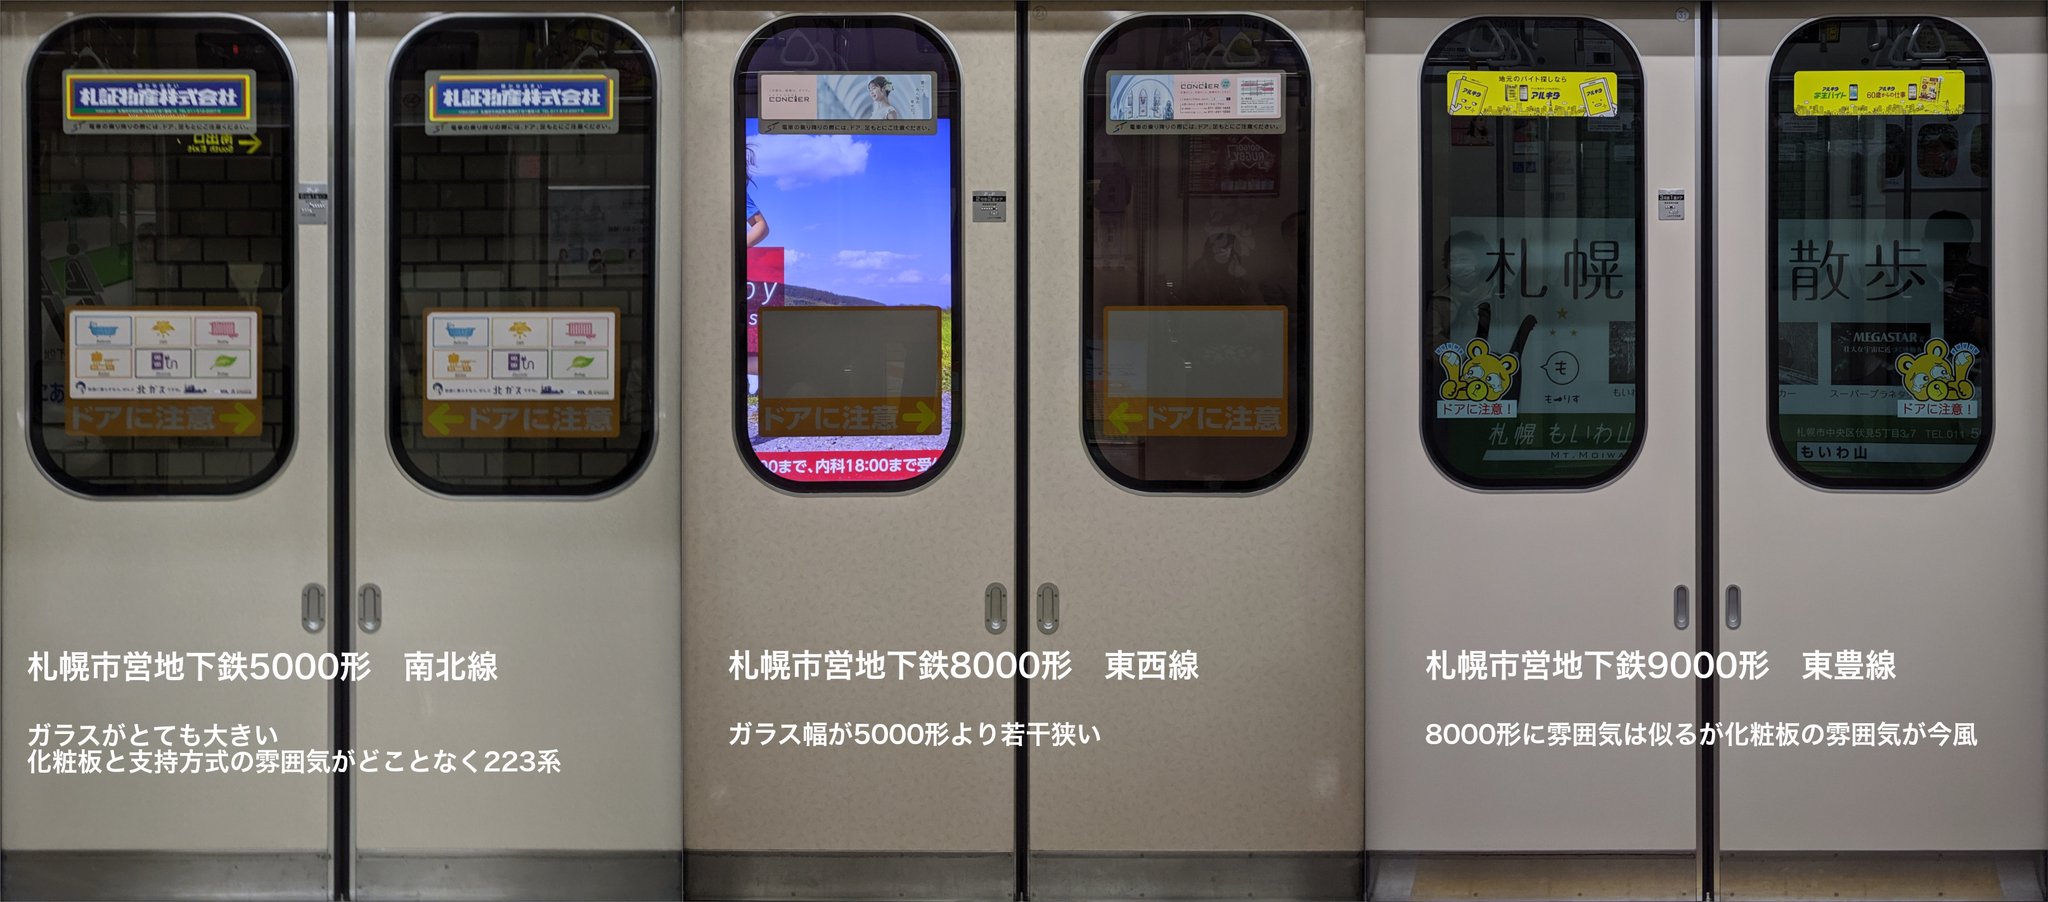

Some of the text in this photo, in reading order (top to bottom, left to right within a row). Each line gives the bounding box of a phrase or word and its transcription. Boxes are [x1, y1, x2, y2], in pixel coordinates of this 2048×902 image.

[443, 88, 600, 107] 札証物産株式会社
[1461, 88, 1482, 98] アルキタ
[1531, 91, 1561, 100] アルキタ
[1586, 88, 1603, 97] アルキタ
[1867, 91, 1906, 99] 60歳からの仕事
[1486, 237, 1624, 300] 札幌
[1789, 239, 1927, 301] 散歩
[72, 406, 216, 432] ドアに注意
[470, 407, 613, 432] ドアに注意
[765, 405, 899, 432] ドアに注意
[1146, 406, 1282, 432] ドアに注意
[1488, 422, 1536, 447] 札幌
[1801, 445, 1868, 460] もいわ山
